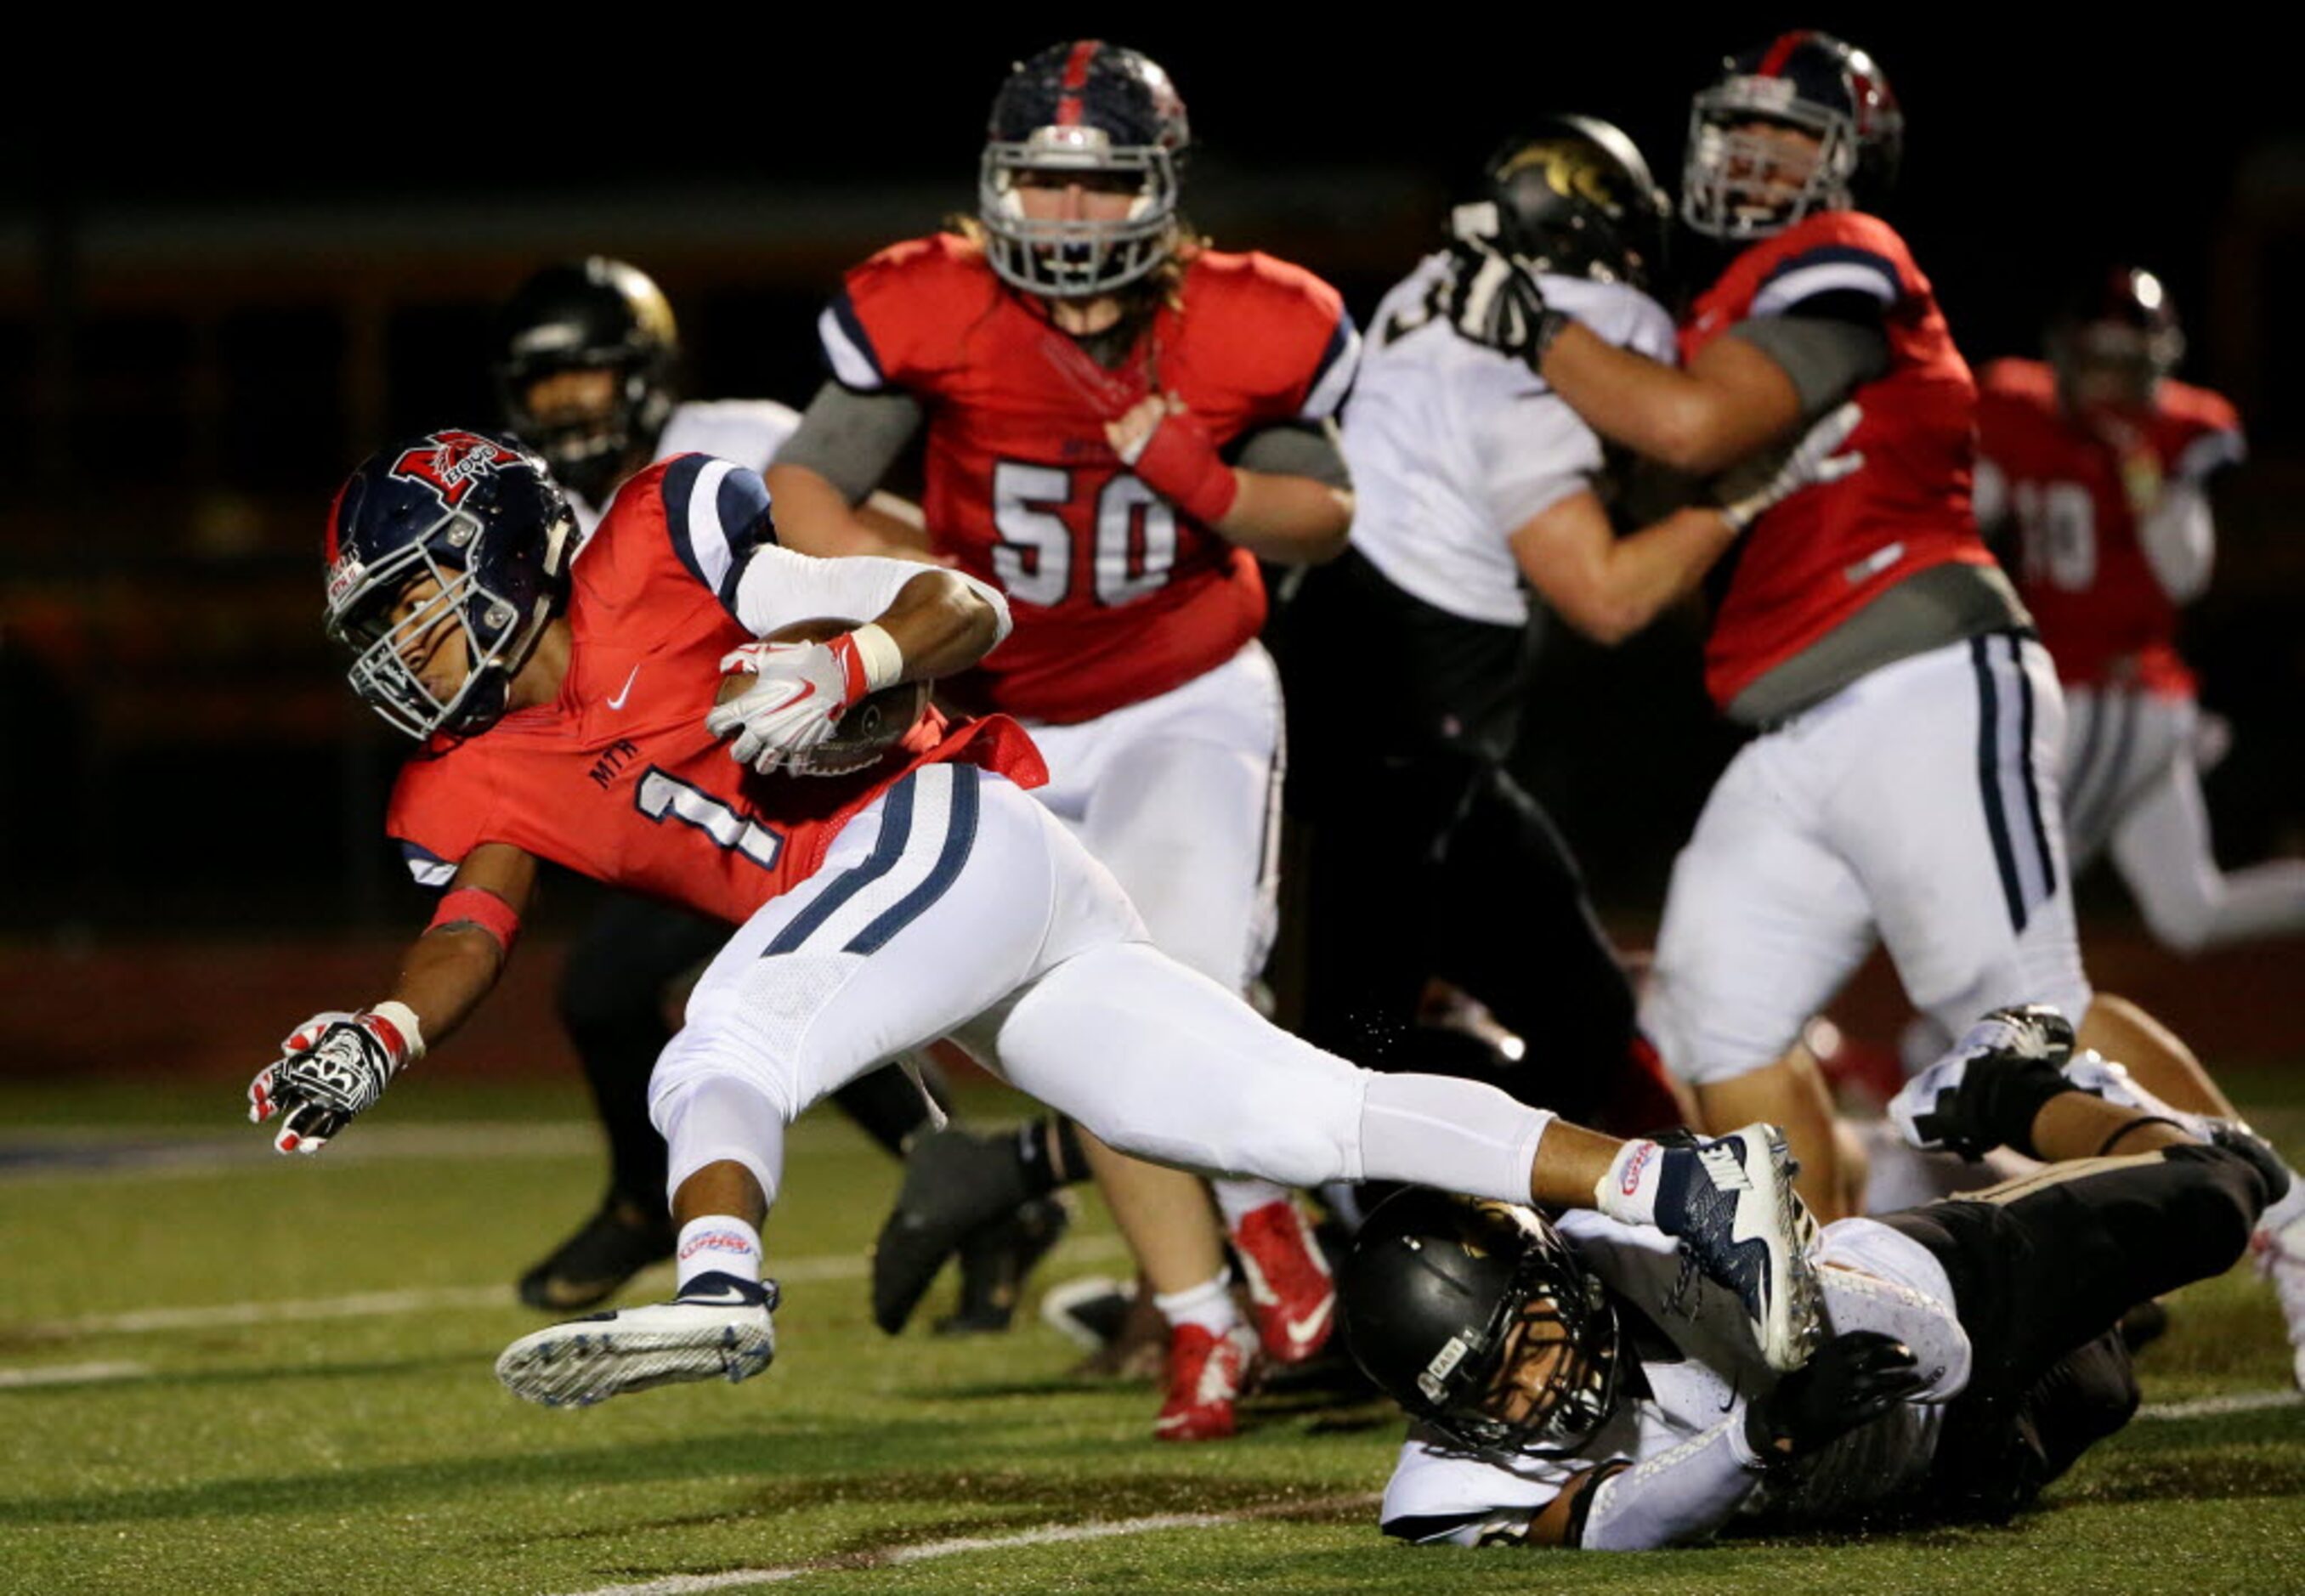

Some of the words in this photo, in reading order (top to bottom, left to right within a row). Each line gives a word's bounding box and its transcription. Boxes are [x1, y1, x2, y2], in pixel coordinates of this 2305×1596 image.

[989, 456, 1177, 608] 50
[633, 763, 789, 872] 1
[1696, 1143, 1753, 1191] NIKE
